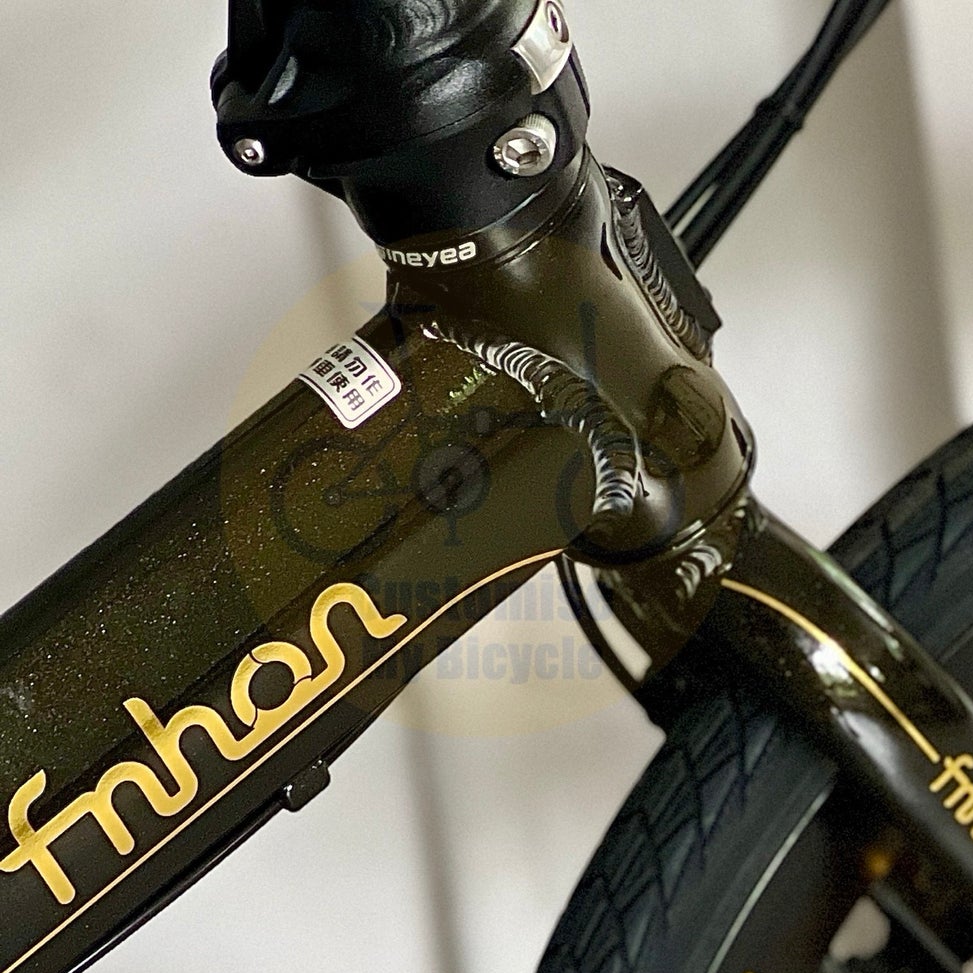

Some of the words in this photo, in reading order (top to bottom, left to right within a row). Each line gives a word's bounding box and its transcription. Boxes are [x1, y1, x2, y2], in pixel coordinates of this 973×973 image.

[309, 357, 365, 411] 車使用
[325, 343, 382, 396] 請勿作
